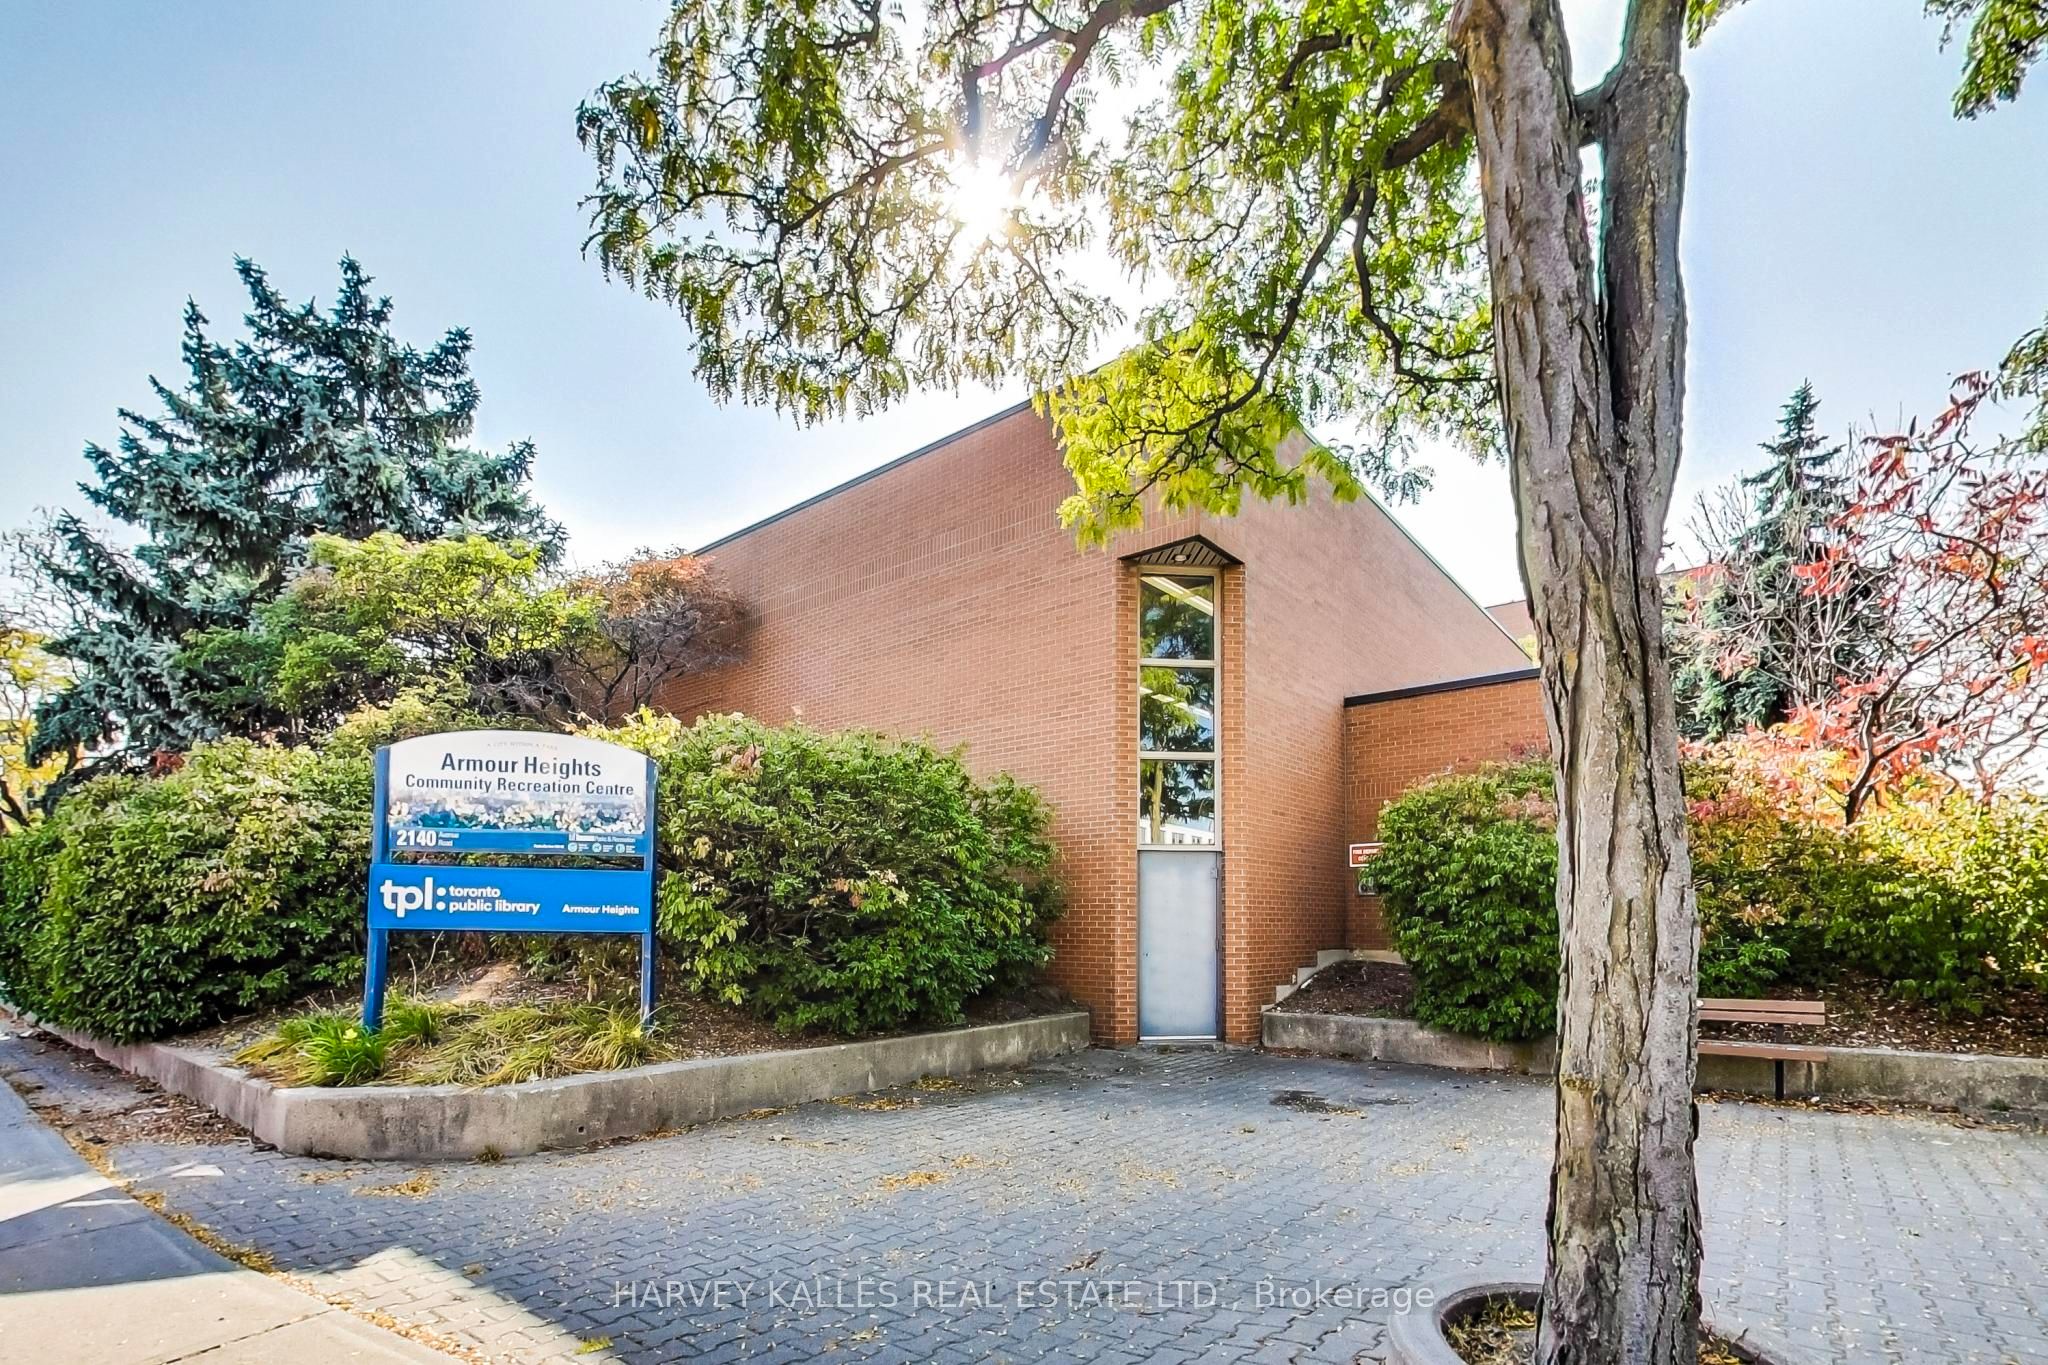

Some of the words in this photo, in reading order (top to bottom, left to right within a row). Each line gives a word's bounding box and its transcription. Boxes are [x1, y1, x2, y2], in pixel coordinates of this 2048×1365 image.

[441, 753, 518, 774] Armour
[524, 757, 602, 779] Heights
[405, 774, 493, 793] Community
[497, 778, 580, 794] Recreation
[586, 781, 635, 796] Centre
[396, 830, 437, 847] 2140
[449, 886, 501, 898] toronto
[449, 899, 493, 914] public
[495, 899, 541, 916] library
[562, 903, 599, 914] Armour
[602, 904, 640, 916] Heights
